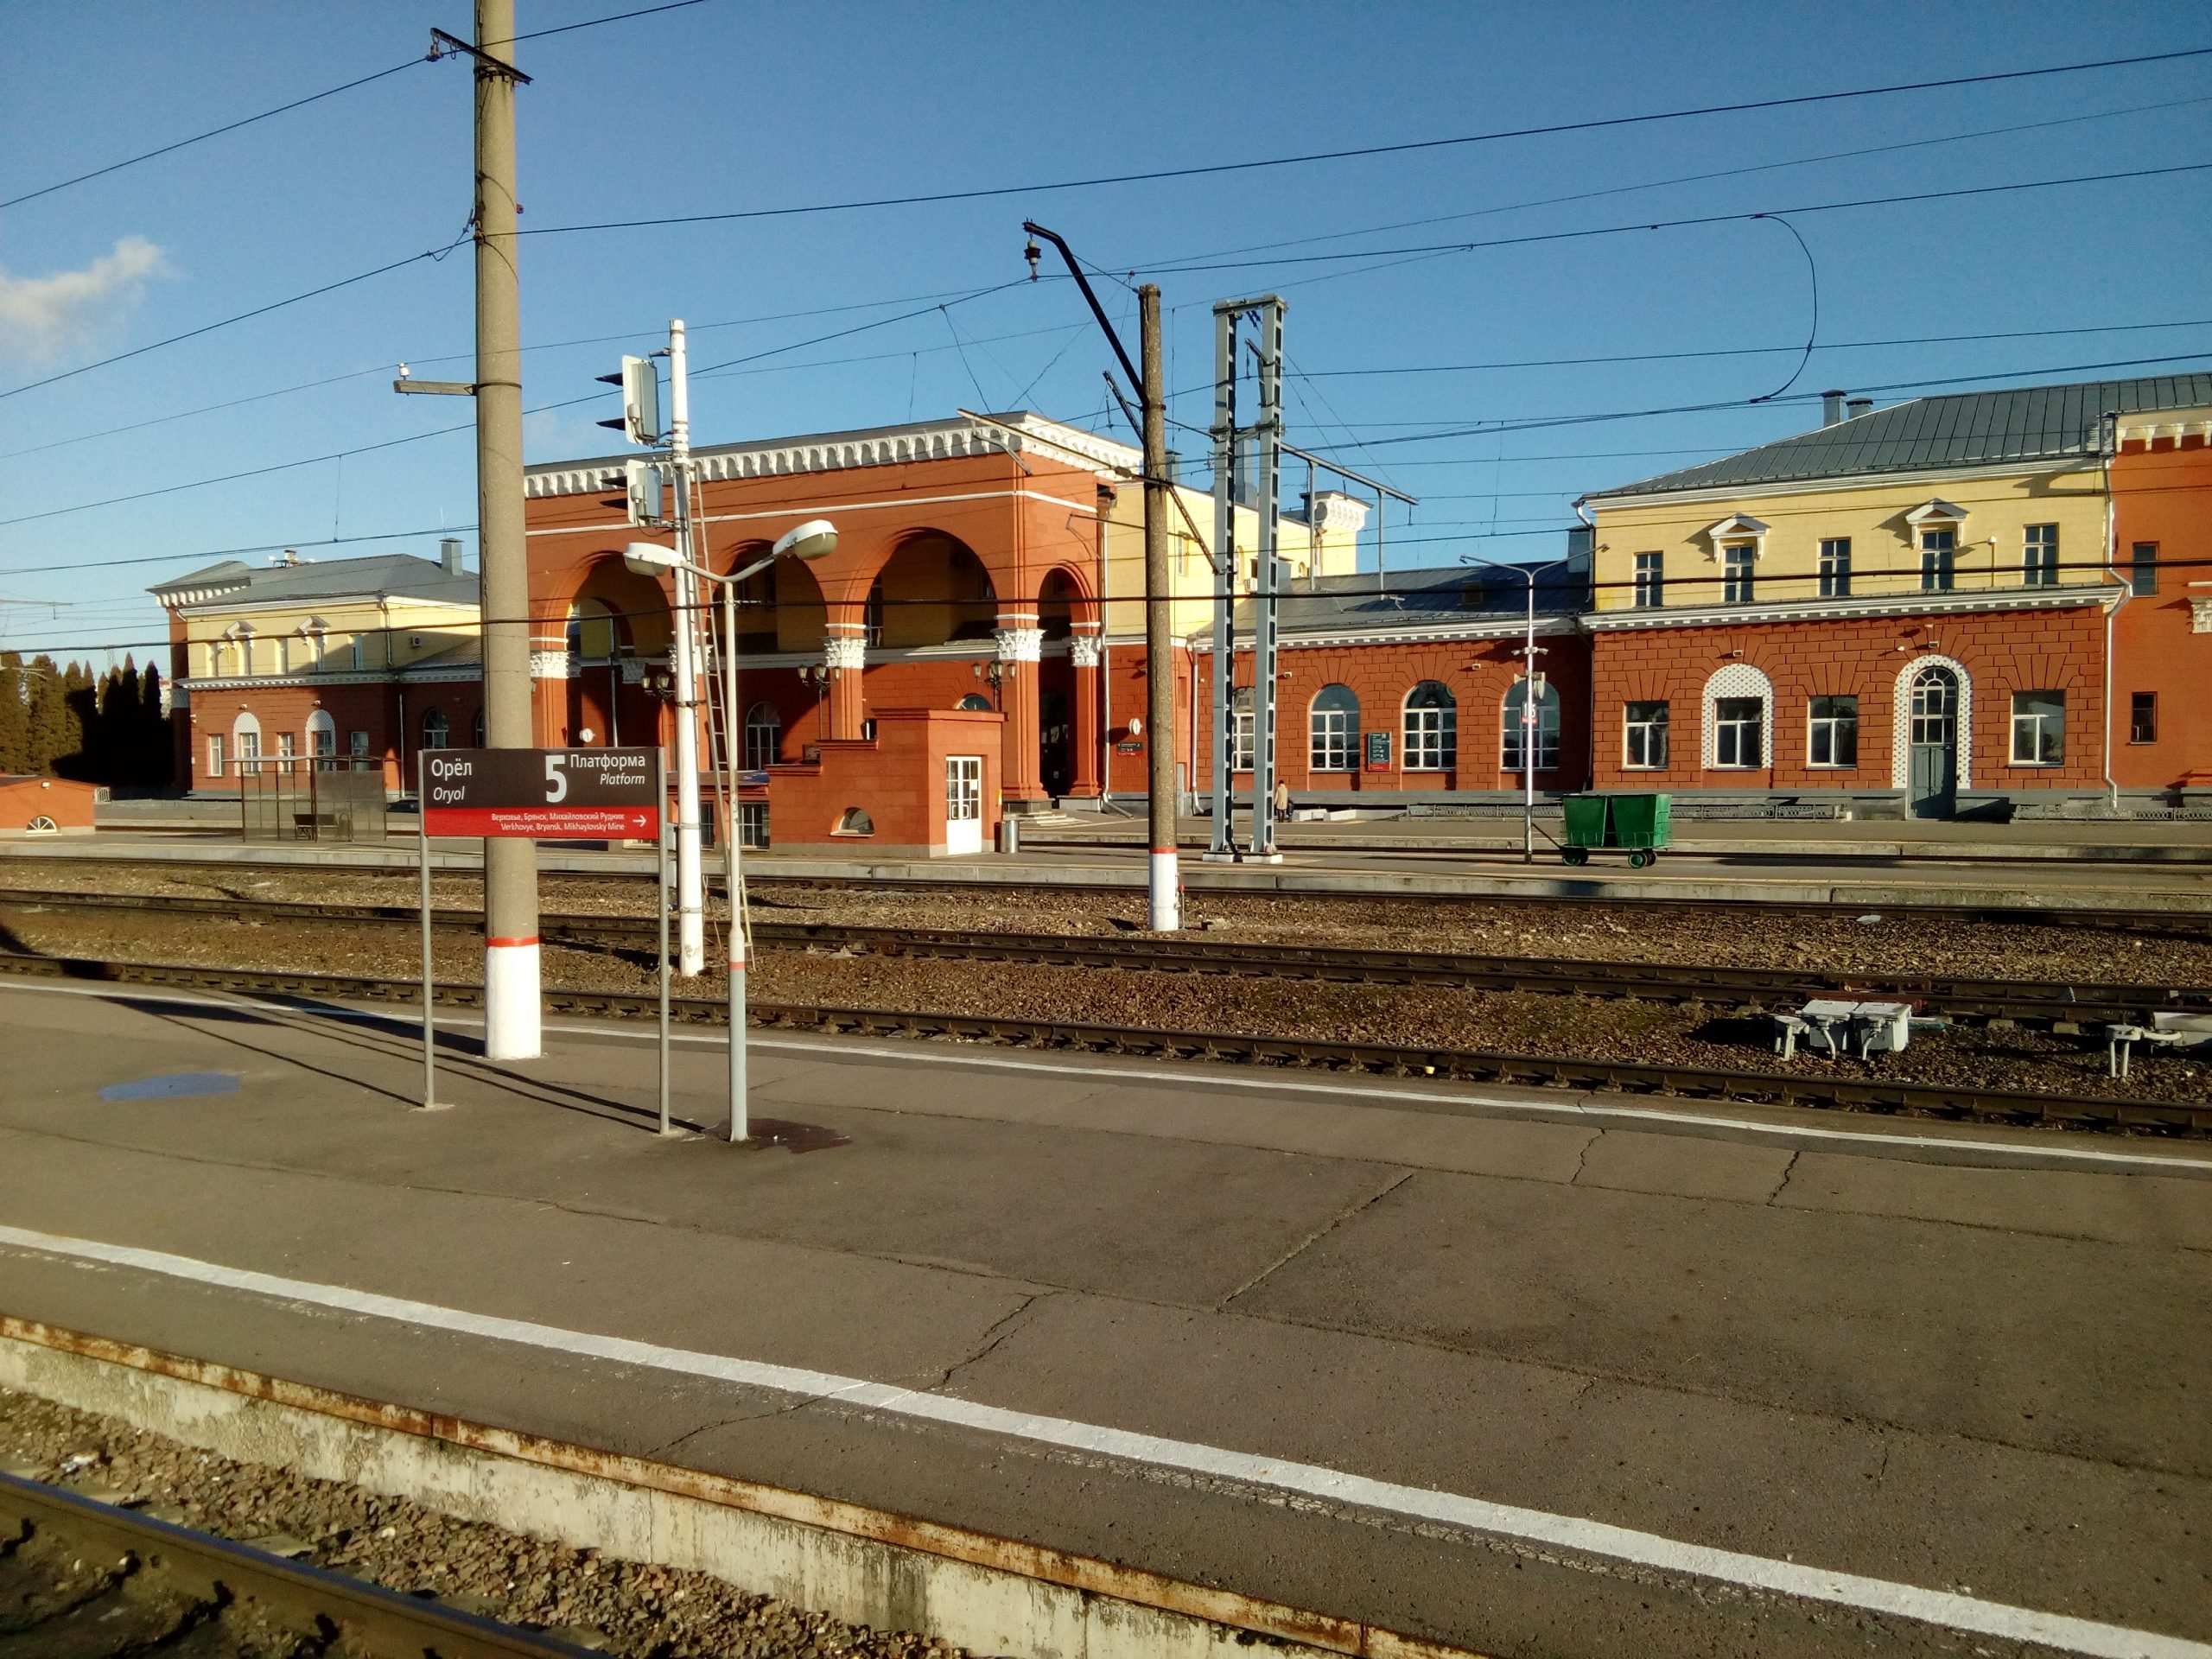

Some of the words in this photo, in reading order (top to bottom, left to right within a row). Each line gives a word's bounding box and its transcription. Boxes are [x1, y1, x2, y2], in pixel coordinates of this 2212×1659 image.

[431, 758, 472, 781] Орёл
[570, 753, 645, 771] Платформа
[545, 754, 567, 803] 5
[600, 772, 645, 785] Platform
[433, 785, 465, 804] Oryol
[491, 813, 523, 822] Верховье,
[524, 812, 549, 822] Брянск,
[600, 812, 625, 822] Рудник
